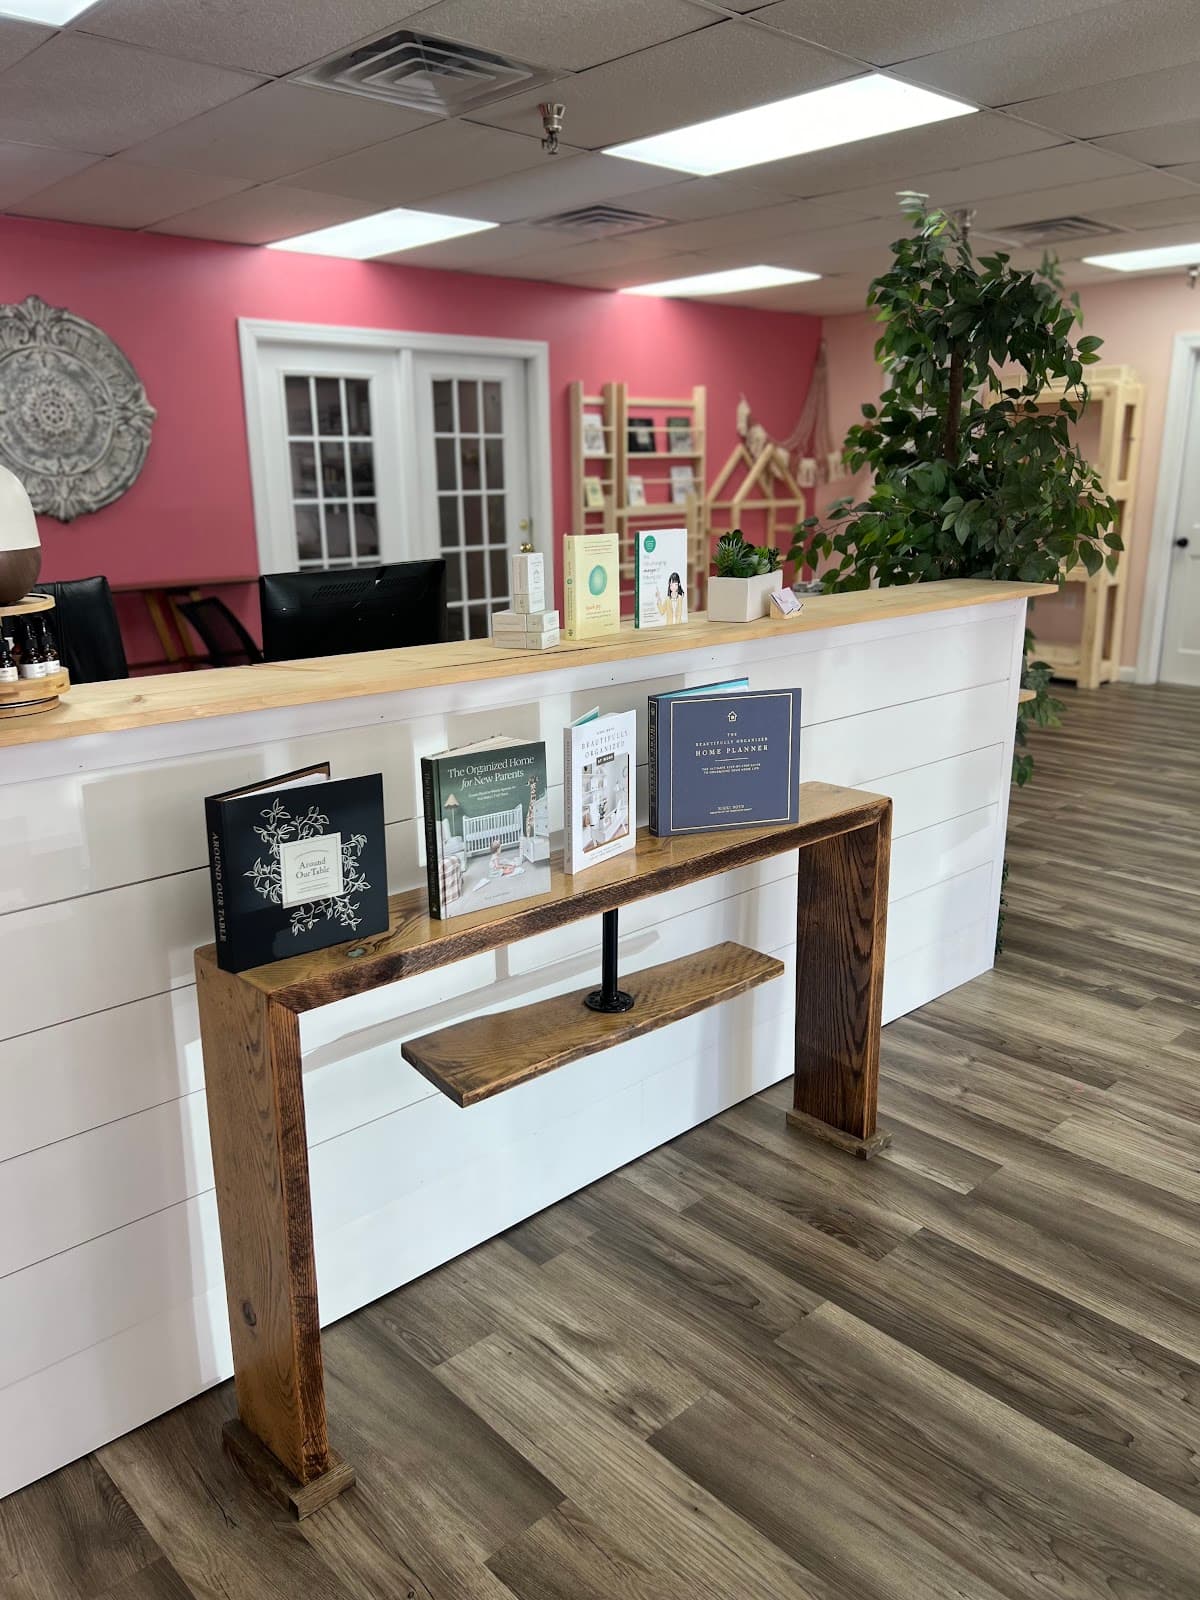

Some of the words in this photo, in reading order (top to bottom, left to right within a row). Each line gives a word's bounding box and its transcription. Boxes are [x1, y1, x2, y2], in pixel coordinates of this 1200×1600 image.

[695, 748, 722, 757] HOME
[726, 744, 768, 754] PLANNER
[447, 767, 465, 779] The
[466, 759, 508, 776] Organized
[509, 756, 535, 767] Home
[460, 777, 472, 791] for
[474, 775, 493, 786] New
[495, 769, 524, 782] Parents
[211, 832, 222, 881] AROUND
[299, 856, 326, 869] Around
[295, 868, 311, 880] Our
[310, 865, 330, 876] Table
[216, 882, 224, 907] OUR
[217, 908, 227, 942] TABLE
